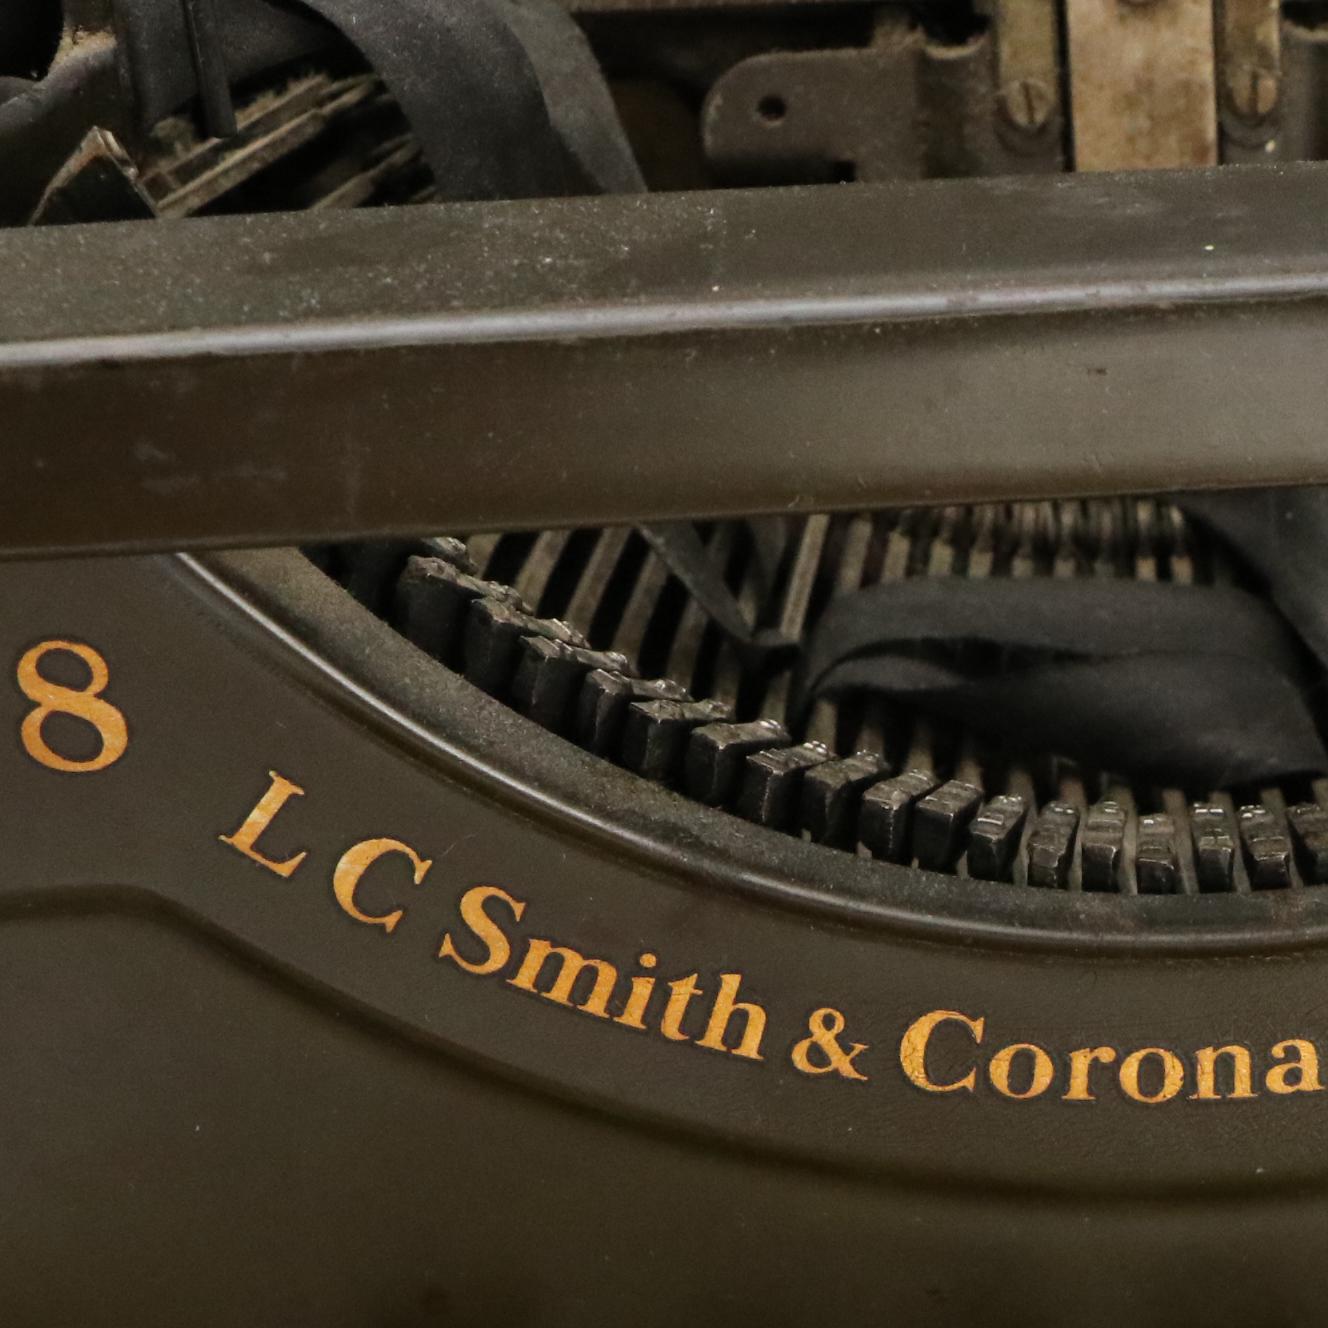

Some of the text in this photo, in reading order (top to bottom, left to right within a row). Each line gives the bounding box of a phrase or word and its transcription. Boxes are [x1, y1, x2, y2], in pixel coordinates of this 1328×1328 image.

[17, 640, 128, 771] 8
[219, 770, 308, 877] L
[333, 838, 432, 930] C
[440, 886, 767, 1059] Smith
[791, 1008, 865, 1079] &
[900, 1010, 1322, 1104] Corona
